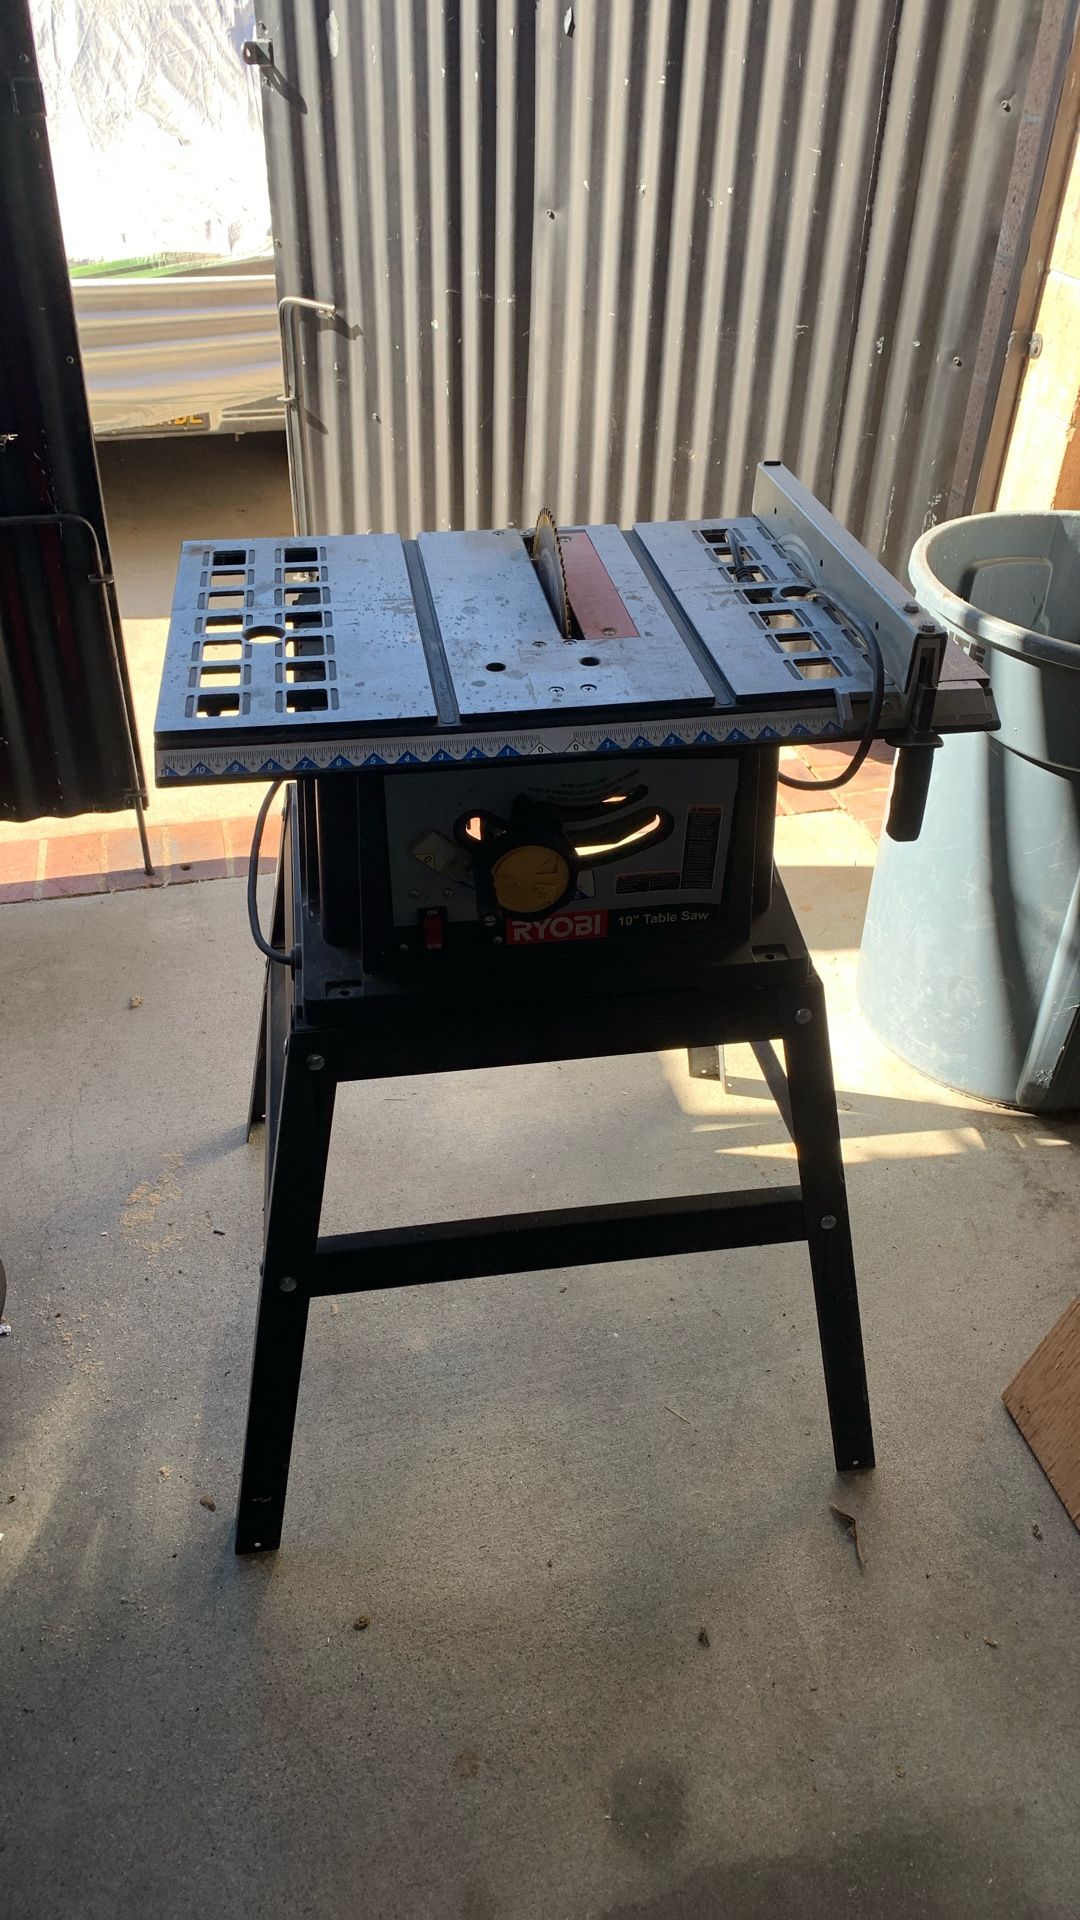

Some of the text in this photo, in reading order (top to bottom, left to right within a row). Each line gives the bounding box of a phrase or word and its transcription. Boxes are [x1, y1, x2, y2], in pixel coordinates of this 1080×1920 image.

[195, 766, 206, 774] 10
[618, 910, 709, 927] 10" Table Saw
[511, 913, 601, 942] RYOBI
